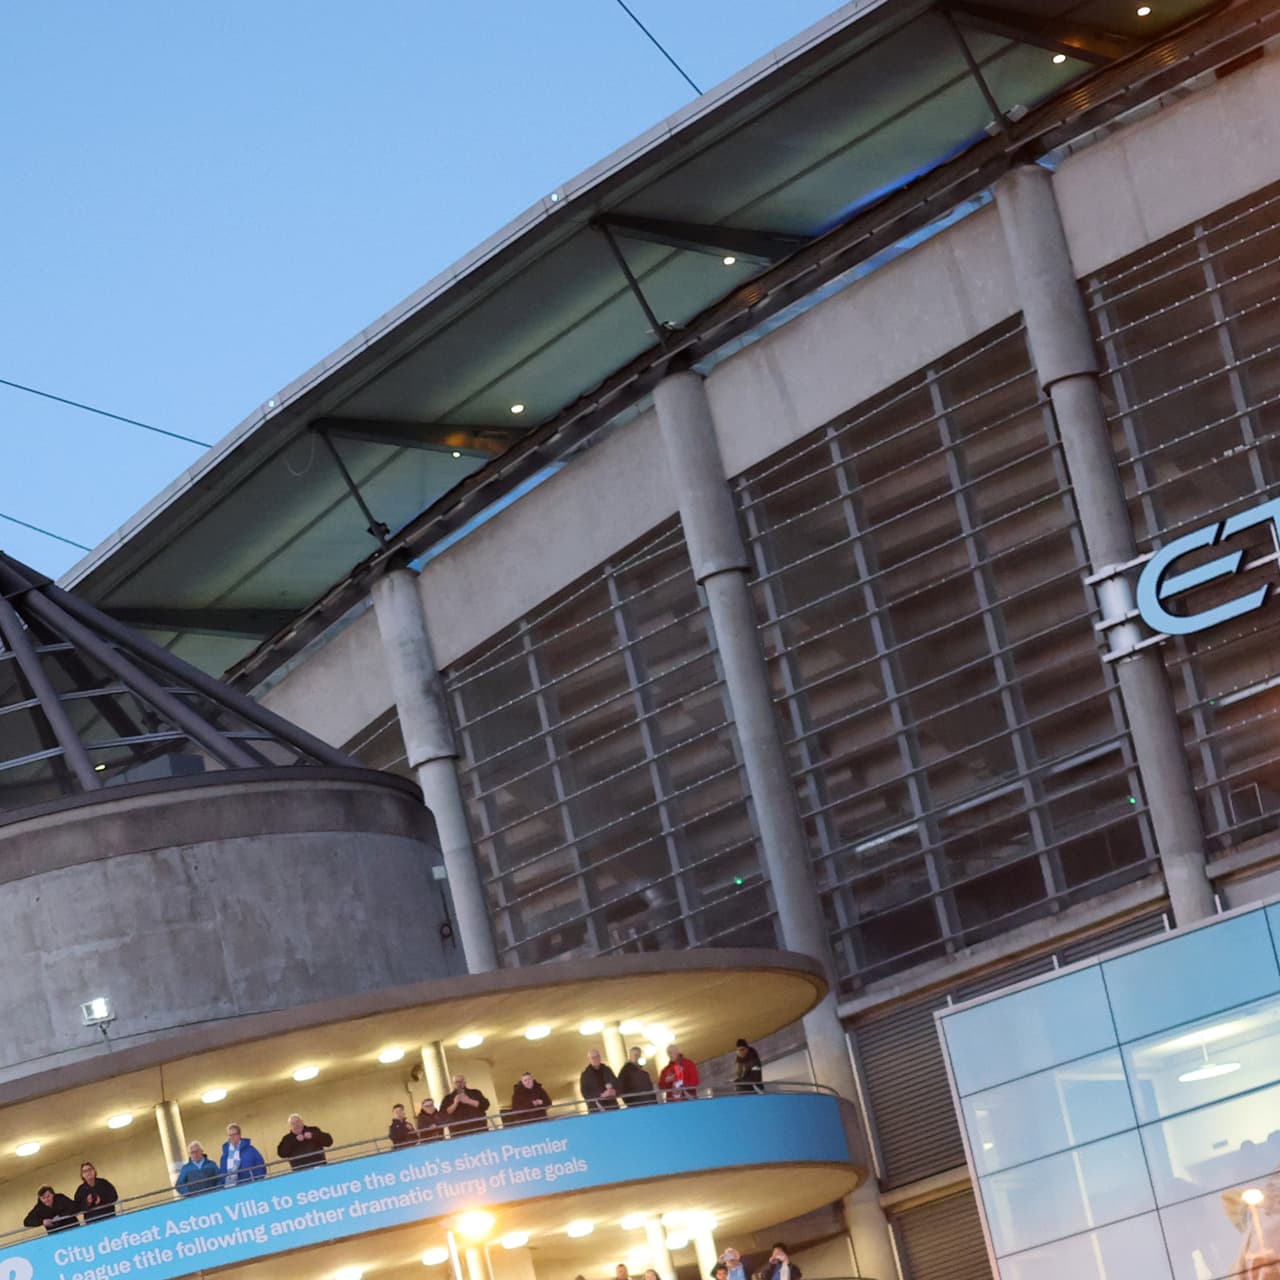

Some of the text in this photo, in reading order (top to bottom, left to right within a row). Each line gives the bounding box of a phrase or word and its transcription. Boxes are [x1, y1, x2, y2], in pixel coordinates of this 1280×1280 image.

[53, 1136, 569, 1269] City defeat Aston Villa to secure the club's sixth Premier
[132, 1245, 173, 1271] title
[175, 1222, 268, 1257] following
[270, 1208, 345, 1237] another
[349, 1187, 434, 1219] dramatic
[436, 1173, 487, 1203] flurry
[488, 1170, 508, 1190] of
[509, 1163, 543, 1185] late
[544, 1156, 589, 1182] goals
